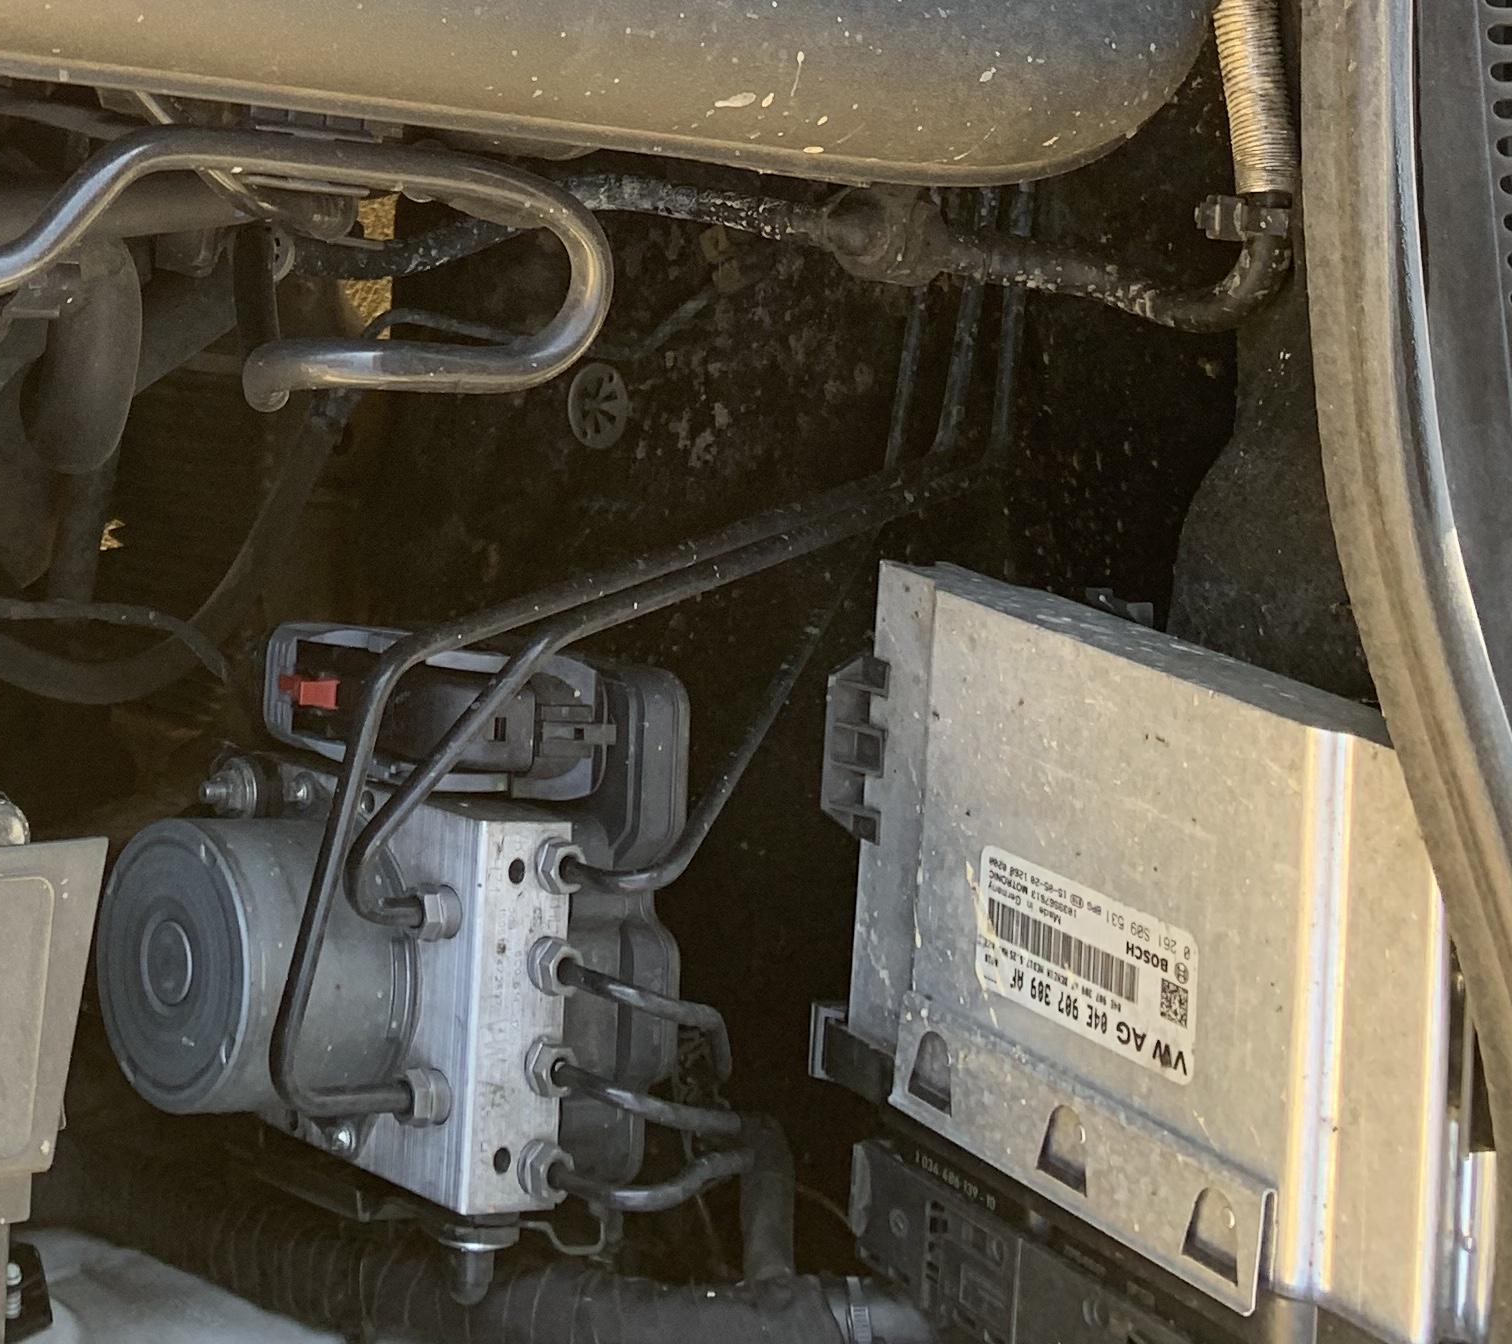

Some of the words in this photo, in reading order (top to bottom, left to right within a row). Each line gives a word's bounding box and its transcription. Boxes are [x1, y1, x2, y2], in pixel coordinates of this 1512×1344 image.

[987, 879, 1021, 905] Germany
[988, 868, 1028, 895] MOTRONIC
[1026, 899, 1033, 910] in
[1038, 904, 1061, 924] Made
[1105, 909, 1124, 929] 531
[1125, 940, 1168, 972] BOSCH
[1157, 933, 1177, 954] 261
[1009, 965, 1023, 993] AF
[1029, 974, 1051, 1007] 309
[1057, 989, 1079, 1020] 907
[1085, 1002, 1107, 1035] 04E
[1115, 1018, 1146, 1054] AG
[1152, 1036, 1188, 1076] VW
